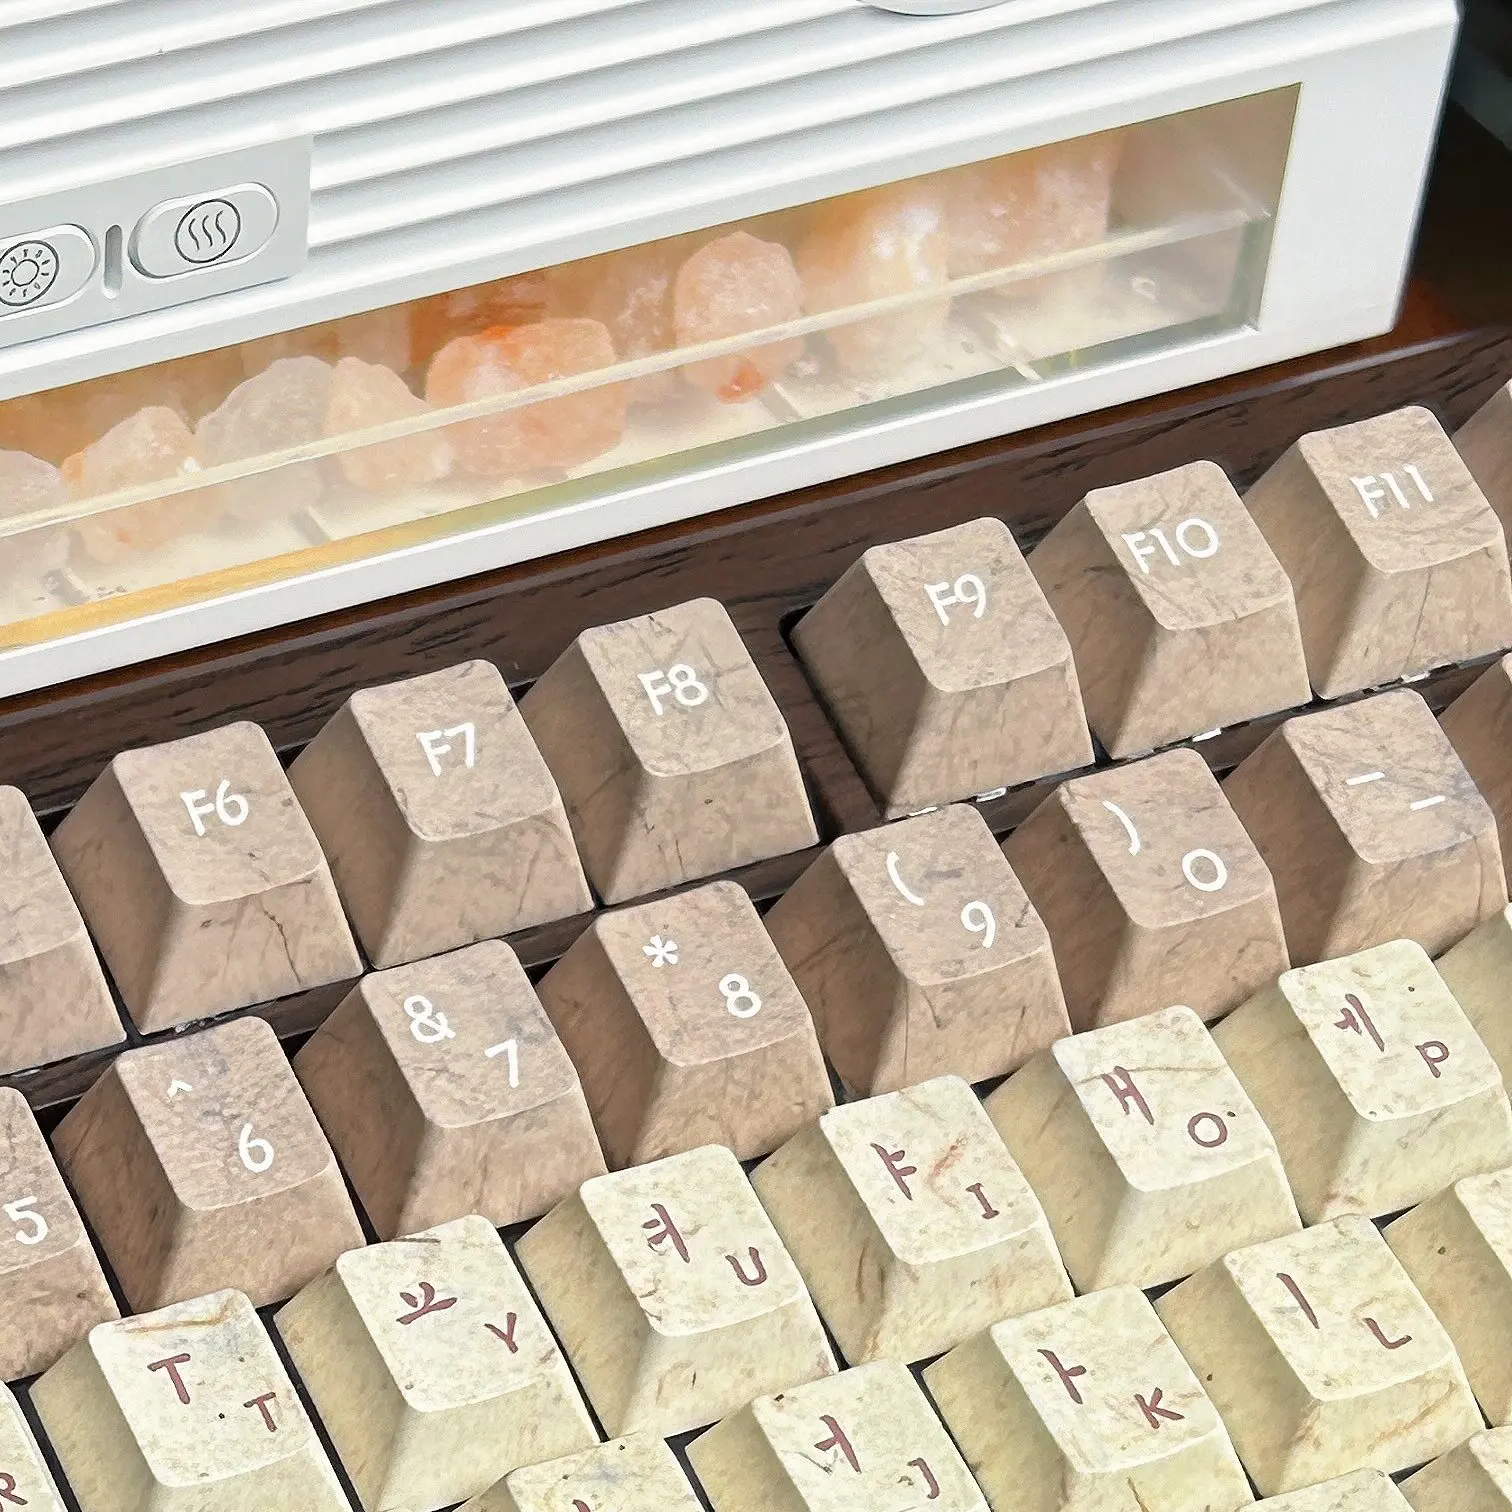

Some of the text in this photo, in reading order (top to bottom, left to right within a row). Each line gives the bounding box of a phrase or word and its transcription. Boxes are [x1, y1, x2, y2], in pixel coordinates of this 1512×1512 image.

[1350, 466, 1435, 518] F11
[1121, 518, 1221, 574] F10
[924, 574, 987, 625] F9
[638, 664, 708, 716] F8
[416, 722, 476, 776] F7
[180, 780, 249, 836] F6
[1102, 801, 1140, 855] )
[886, 851, 924, 905] (
[960, 901, 996, 948] 9
[403, 995, 455, 1044] &
[718, 974, 762, 1019] 8
[485, 1040, 520, 1088] 7
[1415, 1039, 1450, 1079] P
[167, 1080, 192, 1098] ^
[238, 1123, 274, 1172] 6
[1188, 1111, 1228, 1149] O
[4, 1196, 48, 1245] 5
[966, 1182, 1000, 1220] I
[724, 1246, 768, 1287] U
[484, 1312, 519, 1353] Y
[1363, 1317, 1413, 1350] L
[244, 1392, 277, 1432] T
[1134, 1387, 1185, 1430] K
[908, 1457, 940, 1501] J
